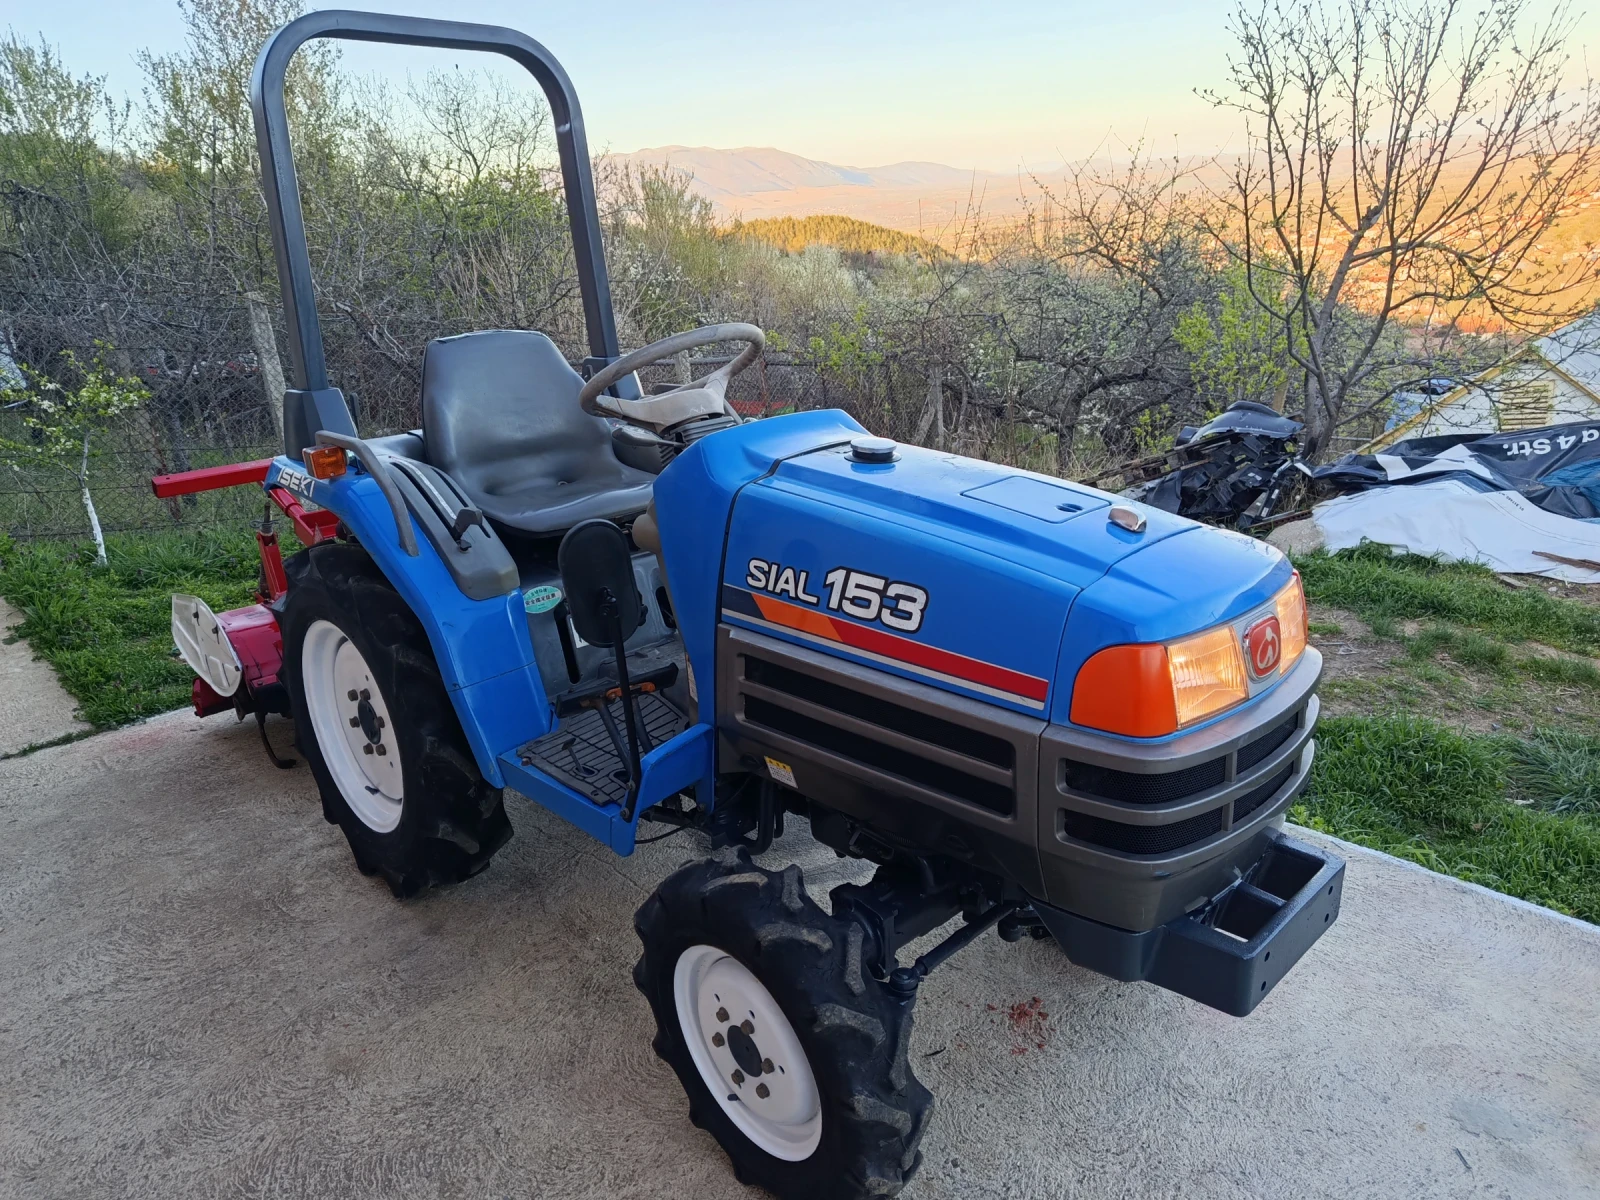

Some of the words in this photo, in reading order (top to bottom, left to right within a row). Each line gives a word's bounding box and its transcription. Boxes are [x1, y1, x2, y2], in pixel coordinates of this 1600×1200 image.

[1502, 438, 1552, 456] Str.
[1557, 435, 1576, 450] 4
[277, 466, 315, 498] ISEKI
[746, 557, 820, 607] SIAL
[824, 566, 929, 634] 153
